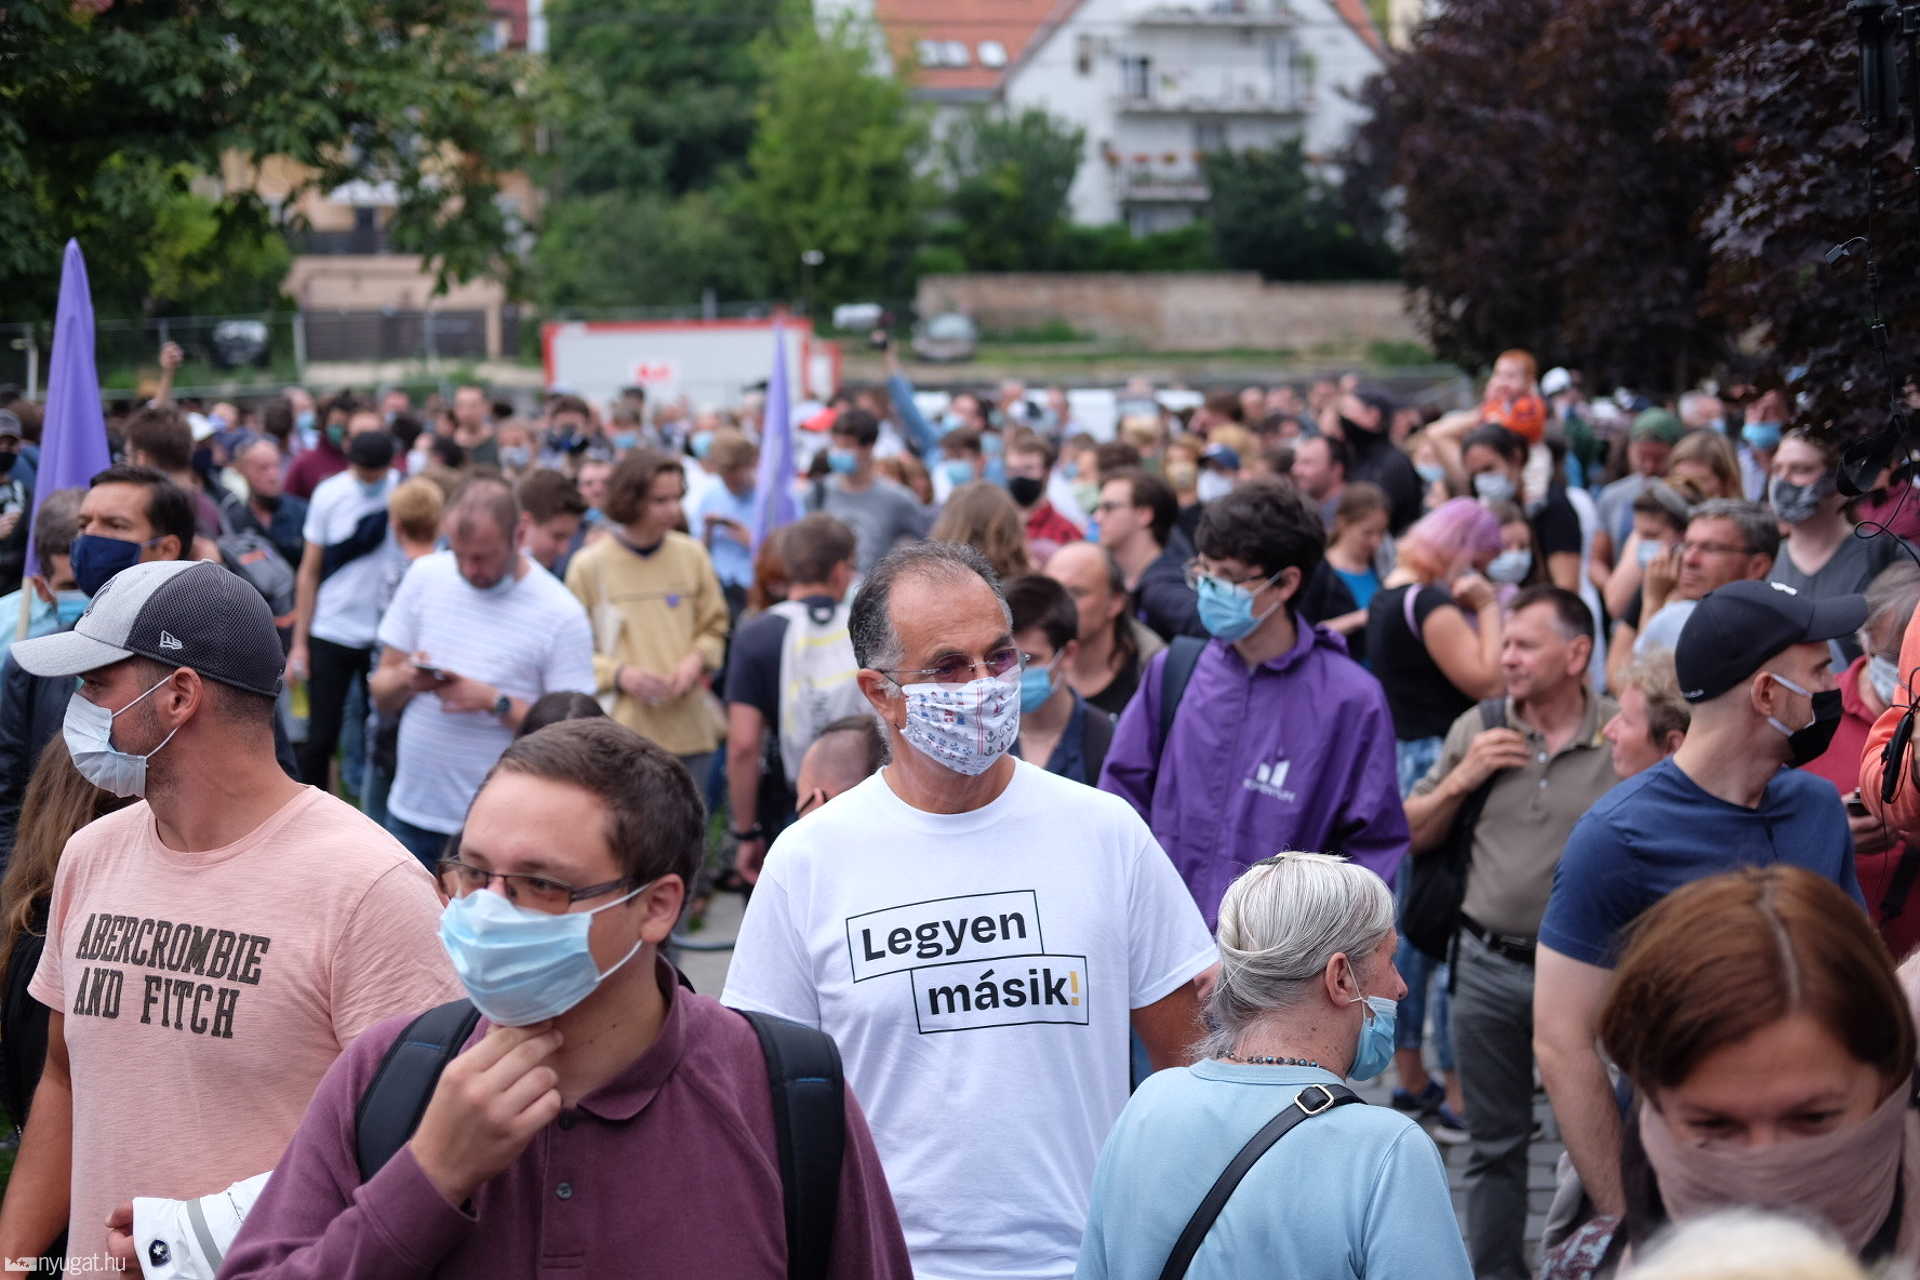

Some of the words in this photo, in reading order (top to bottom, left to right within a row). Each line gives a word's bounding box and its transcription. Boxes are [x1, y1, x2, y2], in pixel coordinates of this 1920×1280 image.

[75, 913, 271, 985] ABERCROMBIE
[862, 912, 1026, 960] Legyen
[73, 967, 124, 1019] AND
[140, 975, 240, 1039] FITCH
[928, 968, 1080, 1015] másik!
